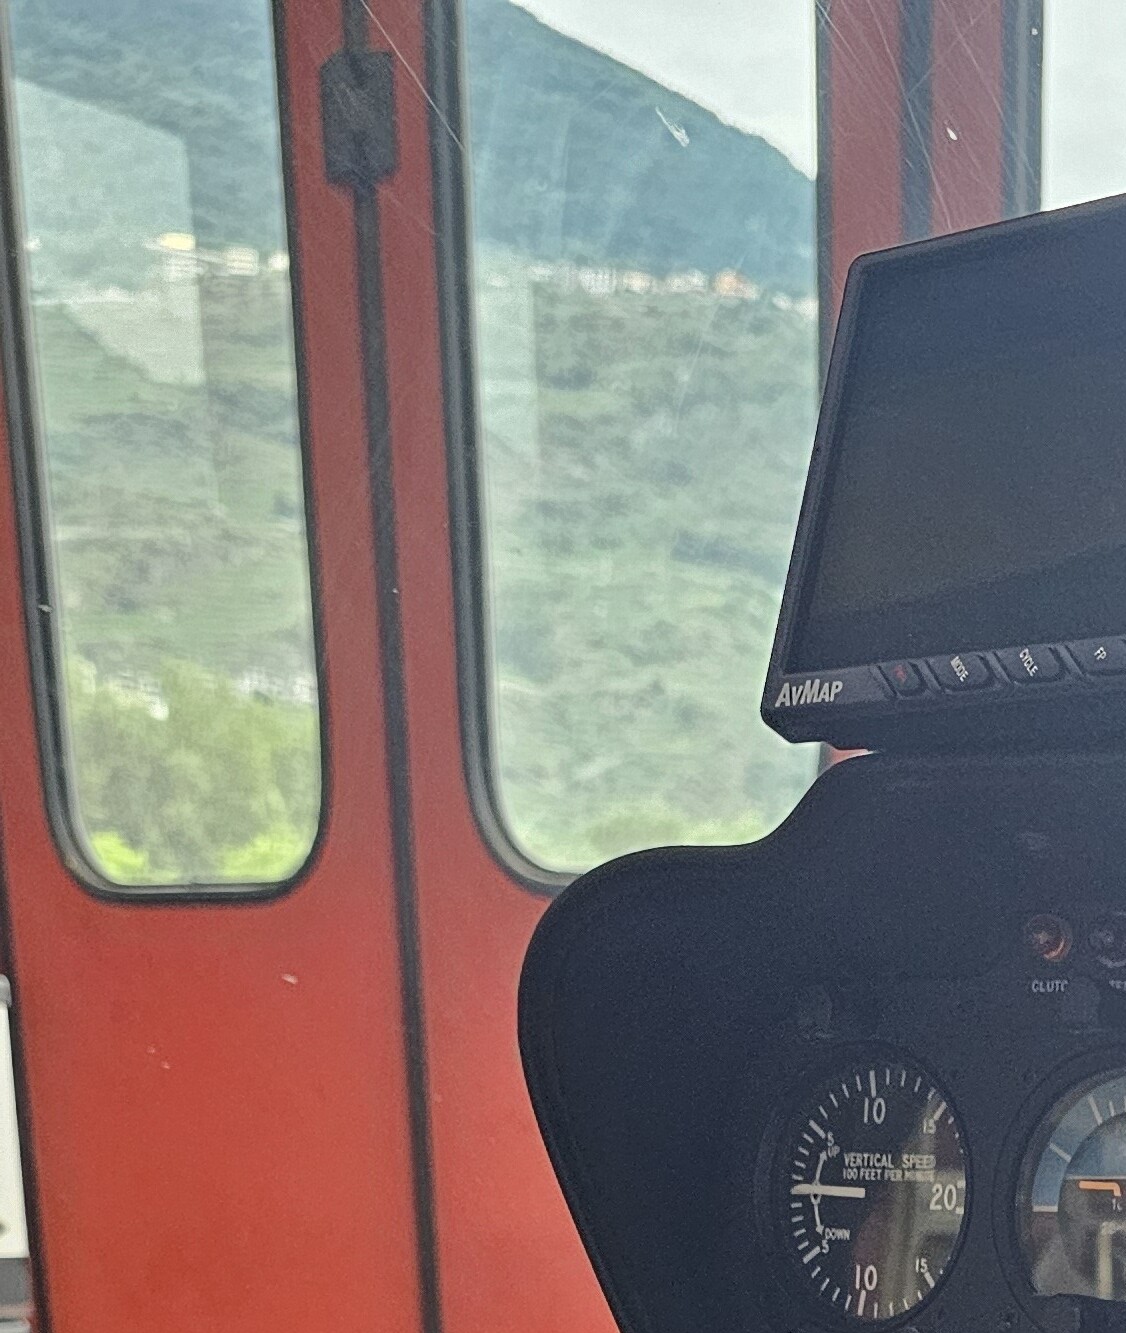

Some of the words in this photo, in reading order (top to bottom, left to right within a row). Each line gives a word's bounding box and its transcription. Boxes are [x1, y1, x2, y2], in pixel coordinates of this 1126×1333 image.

[949, 655, 971, 683] MODE
[863, 1096, 887, 1125] 10
[843, 1152, 894, 1169] VERTICAL
[902, 1154, 937, 1169] SPEED
[929, 1183, 957, 1212] 20
[855, 1264, 878, 1291] 10
